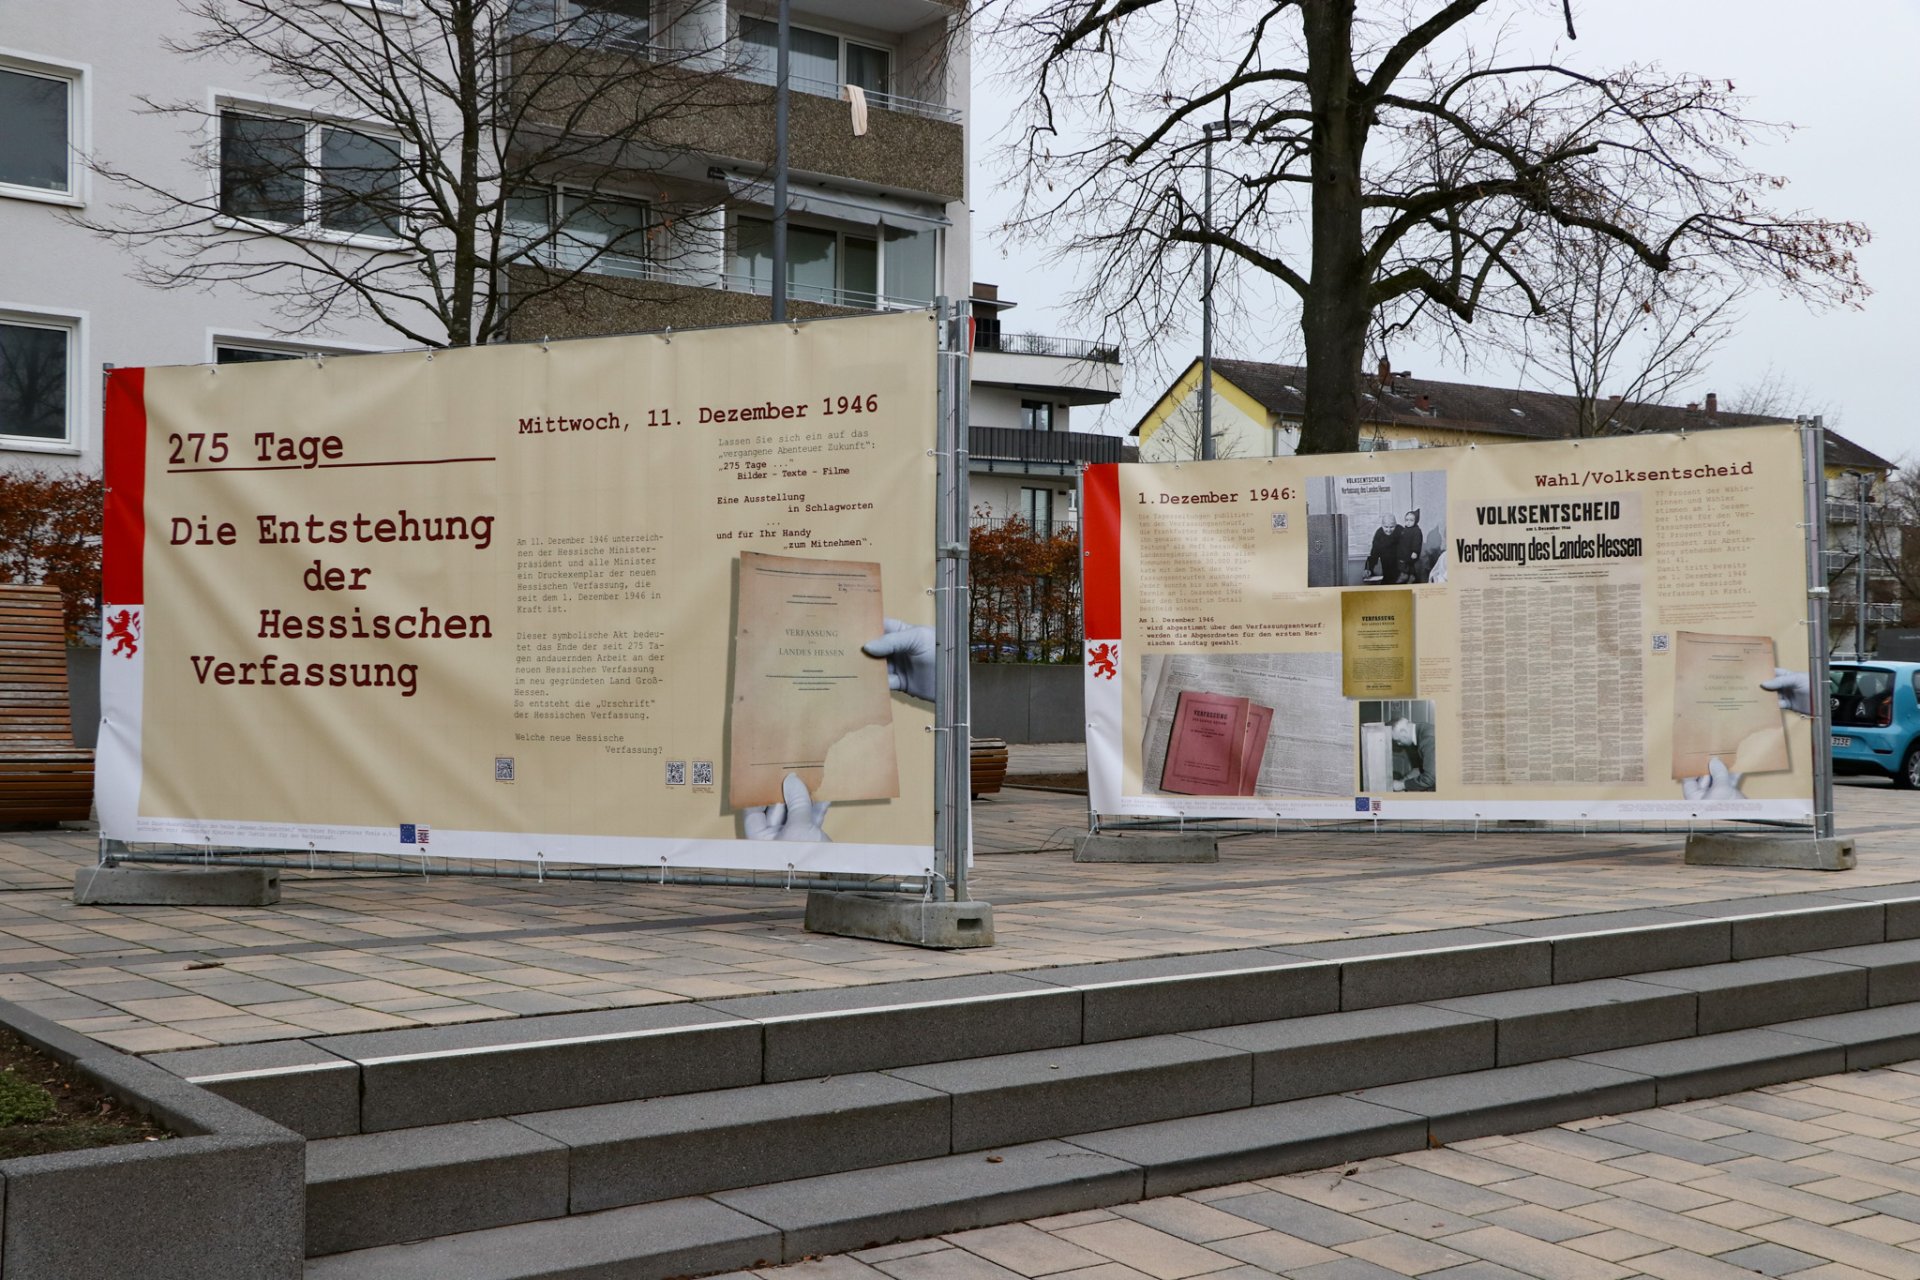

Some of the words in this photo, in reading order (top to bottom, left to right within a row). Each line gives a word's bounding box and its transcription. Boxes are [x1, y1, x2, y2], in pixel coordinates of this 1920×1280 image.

[518, 412, 630, 435] Mittwoch,
[648, 409, 682, 427] 11.
[699, 402, 808, 424] Dezember
[822, 394, 878, 416] 1946
[718, 437, 752, 446] Lassen
[757, 435, 774, 444] Sie
[779, 433, 802, 442] sich
[807, 432, 824, 441] ein
[829, 430, 846, 439] auf
[852, 429, 869, 438] das
[168, 432, 229, 465] 275
[255, 432, 344, 469] Tage
[737, 470, 768, 480] Bilder
[783, 468, 809, 477] Texte
[824, 467, 850, 476] Filme
[1535, 461, 1754, 488] Wahl/Volksentscheid
[717, 495, 739, 504] Eine
[744, 494, 805, 504] Ausstellung
[1138, 492, 1155, 505] 1.
[1160, 490, 1239, 505] Dezember
[1249, 488, 1297, 502] 1946:
[788, 504, 799, 512] in
[805, 501, 873, 513] Schlagworten
[1476, 501, 1620, 525] VOLKSENTSCHEID
[170, 514, 236, 546] Die
[257, 510, 495, 550] Entstehung
[716, 530, 733, 538] und
[738, 529, 755, 538] für
[761, 528, 778, 537] Ihr
[783, 528, 811, 538] Handy
[517, 537, 526, 546] Am
[531, 537, 544, 545] 11.
[549, 536, 586, 545] Dezember
[590, 535, 608, 544] 1946
[613, 533, 663, 543] unterzeich-
[538, 548, 554, 556] der
[559, 547, 605, 556] Hessische
[610, 546, 656, 555] Minister-
[1456, 538, 1526, 566] Verfassung
[1528, 537, 1550, 561] des
[1552, 534, 1595, 560] Landes
[1596, 533, 1642, 558] Hessen
[517, 558, 564, 570] präsident
[569, 558, 584, 566] und
[589, 557, 610, 566] alle
[615, 556, 656, 565] Minister
[303, 560, 372, 591] der
[517, 571, 533, 579] ein
[538, 569, 605, 580] Druckexemplar
[610, 569, 625, 577] der
[517, 581, 568, 590] Hessischen
[573, 580, 630, 590] Verfassung,
[635, 579, 651, 588] die
[517, 593, 538, 602] seit
[543, 593, 558, 601] dem
[563, 592, 574, 601] 1.
[579, 592, 620, 601] Dezember
[625, 591, 646, 600] 1946
[650, 591, 661, 599] in
[517, 604, 542, 613] Kraft
[547, 604, 567, 612] ist.
[257, 607, 493, 639] Hessischen
[517, 631, 547, 639] Dieser
[552, 630, 608, 641] symbolische
[613, 630, 629, 638] Akt
[634, 630, 664, 638] bedeu-
[516, 642, 532, 651] tet
[537, 642, 552, 650] das
[557, 642, 578, 650] Ende
[583, 642, 598, 650] der
[603, 641, 623, 650] seit
[628, 641, 644, 650] 275
[649, 641, 664, 649] Ta-
[516, 656, 531, 664] gen
[536, 653, 593, 662] andauernden
[597, 653, 628, 661] Arbeit
[649, 652, 664, 661] der
[546, 665, 598, 673] Hessischen
[603, 664, 654, 675] Verfassung
[190, 655, 418, 697] Verfassung
[515, 676, 525, 685] im
[550, 676, 607, 687] gegründeten
[612, 676, 632, 685] Land
[637, 676, 663, 684] Groß-
[514, 688, 549, 696] Hessen.
[514, 699, 524, 708] So
[529, 699, 571, 708] entsteht
[576, 699, 592, 707] die
[514, 710, 530, 719] der
[535, 710, 587, 719] Hessischen
[592, 710, 649, 721] Verfassung.
[515, 733, 546, 742] Welche
[577, 733, 624, 742] Hessische
[605, 745, 663, 756] Verfassung?
